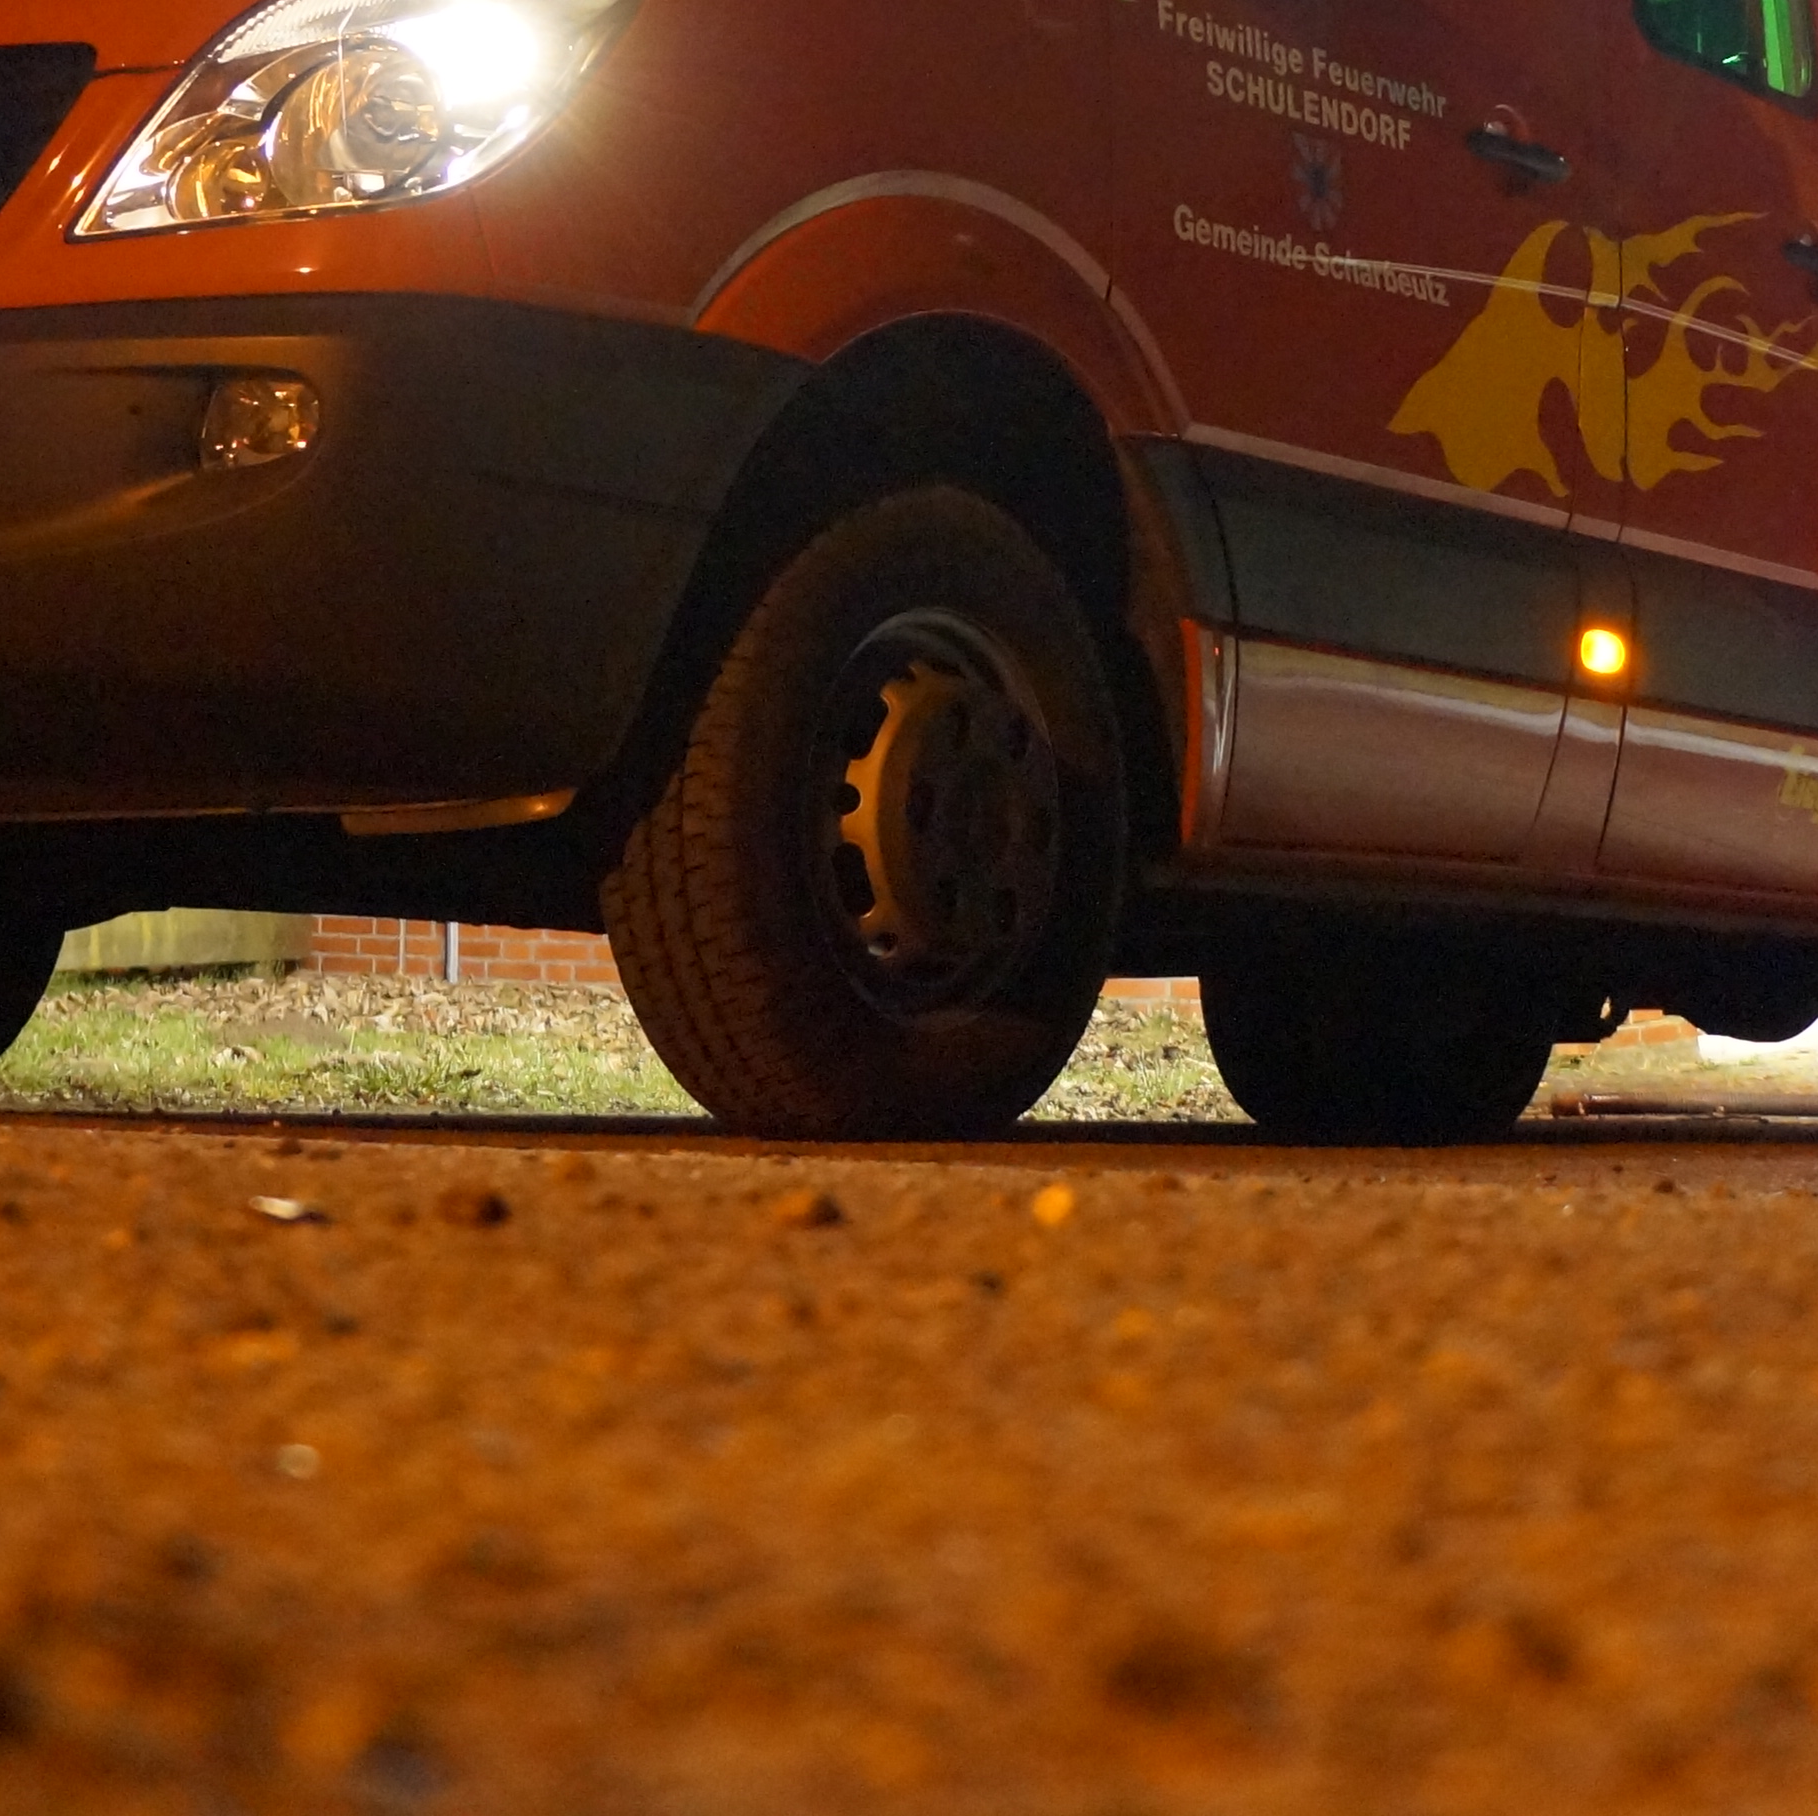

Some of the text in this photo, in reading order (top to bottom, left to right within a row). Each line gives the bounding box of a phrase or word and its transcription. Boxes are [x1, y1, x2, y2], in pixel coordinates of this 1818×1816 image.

[1206, 60, 1412, 150] SCHULENDORF
[1312, 46, 1447, 118] Feuerwehr
[1173, 204, 1450, 307] Gemeinde Scharbeutz
